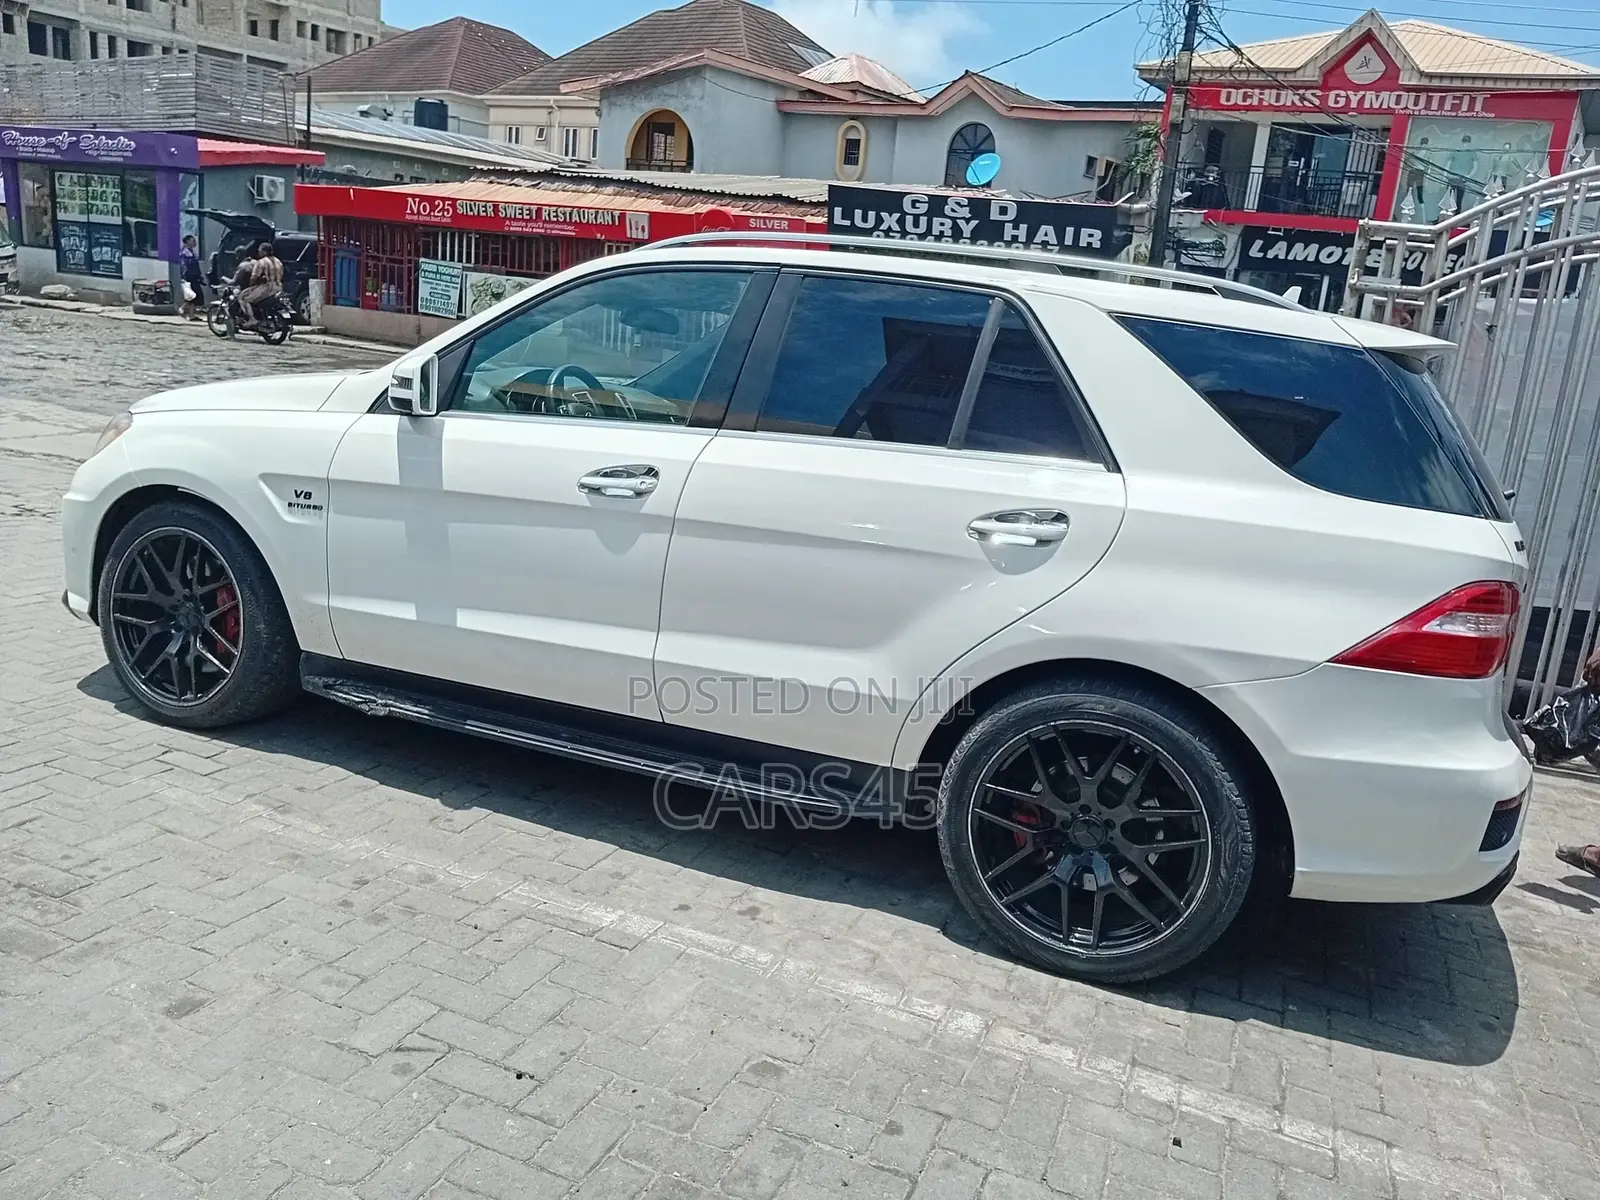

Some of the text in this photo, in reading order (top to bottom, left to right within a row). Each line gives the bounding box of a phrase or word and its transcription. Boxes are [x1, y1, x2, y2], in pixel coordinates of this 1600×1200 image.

[1220, 88, 1491, 112] OCHUKS GYMOUTFIT
[2, 130, 47, 147] House
[405, 197, 620, 226] No.25 SILVER SWEET RESTAURANT
[902, 194, 1017, 222] G & D
[749, 218, 789, 230] SILVER
[833, 207, 980, 238] LUXURY
[1003, 222, 1102, 249] HAIR
[294, 489, 312, 500] V8
[288, 502, 323, 511] BITURBO
